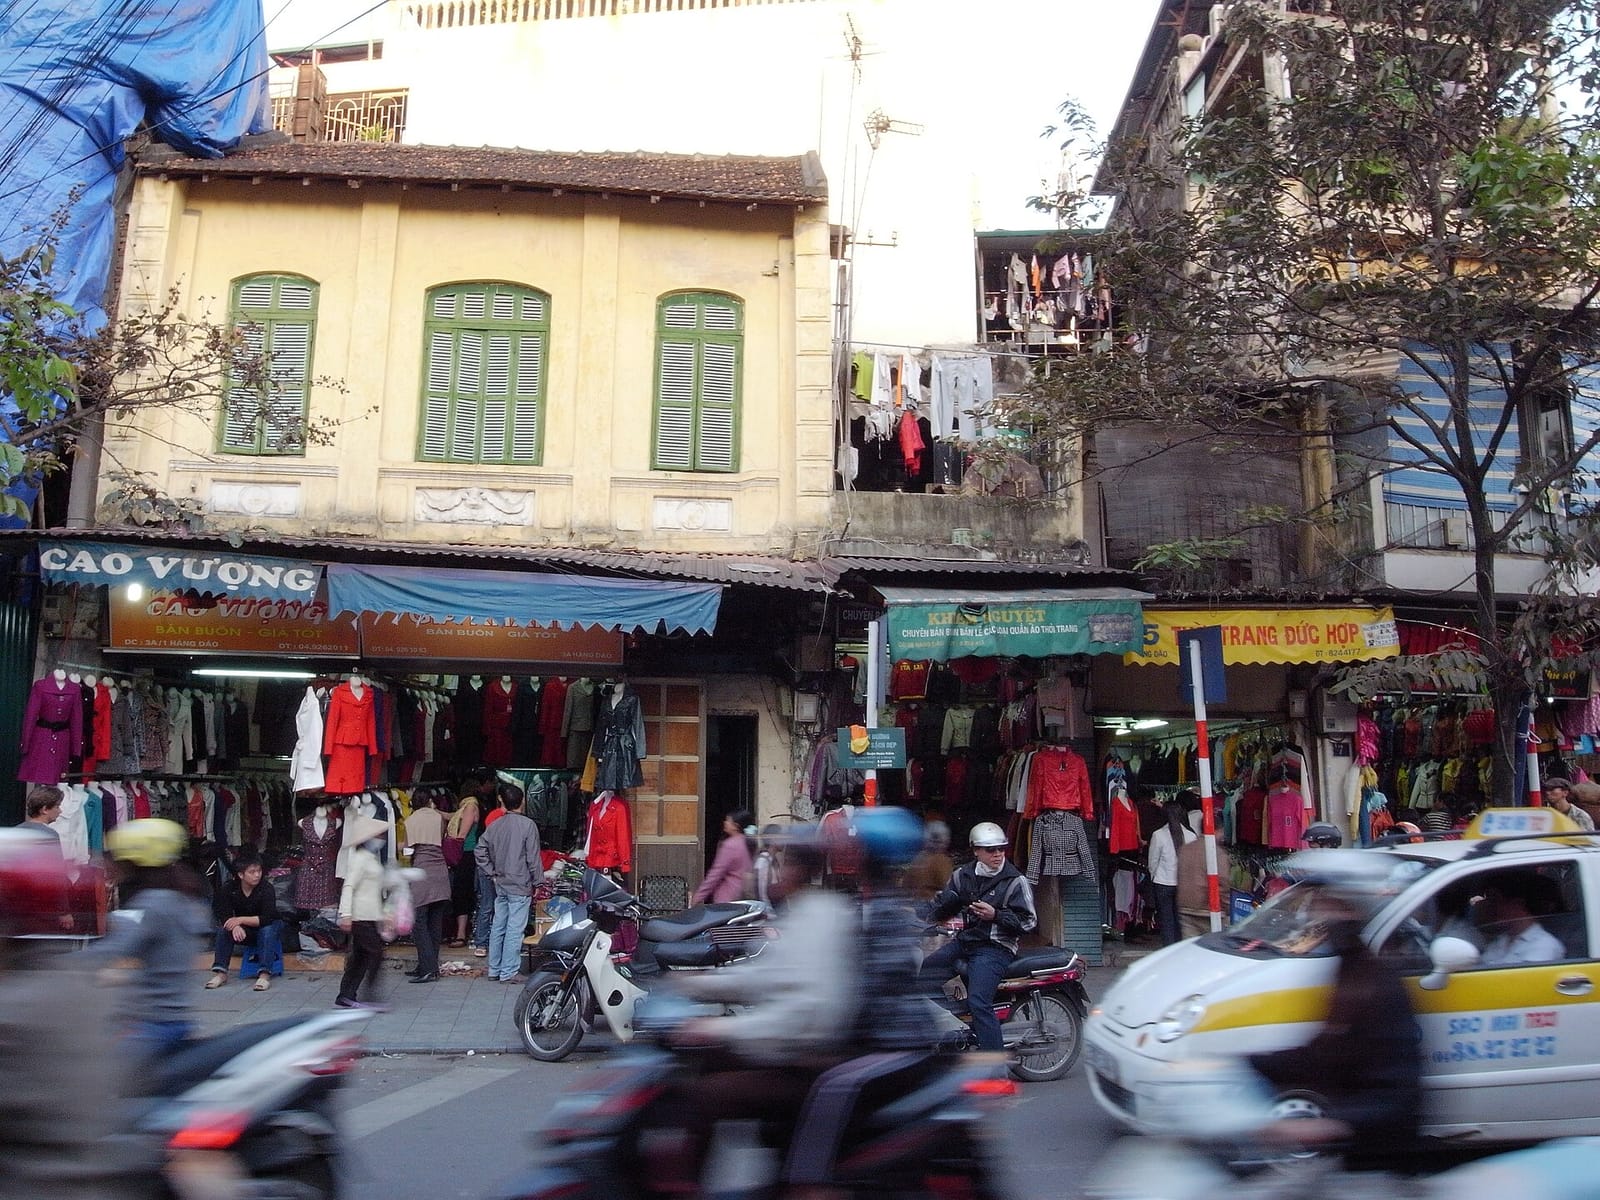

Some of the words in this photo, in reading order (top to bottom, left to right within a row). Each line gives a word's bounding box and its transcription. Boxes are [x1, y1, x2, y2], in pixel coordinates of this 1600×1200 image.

[40, 548, 134, 575] CAO
[147, 556, 316, 591] VƯỢNG
[146, 600, 208, 617] CAO
[1221, 625, 1279, 646] TRANG
[1284, 620, 1320, 646] ĐỨC
[1326, 622, 1359, 649] HỢP
